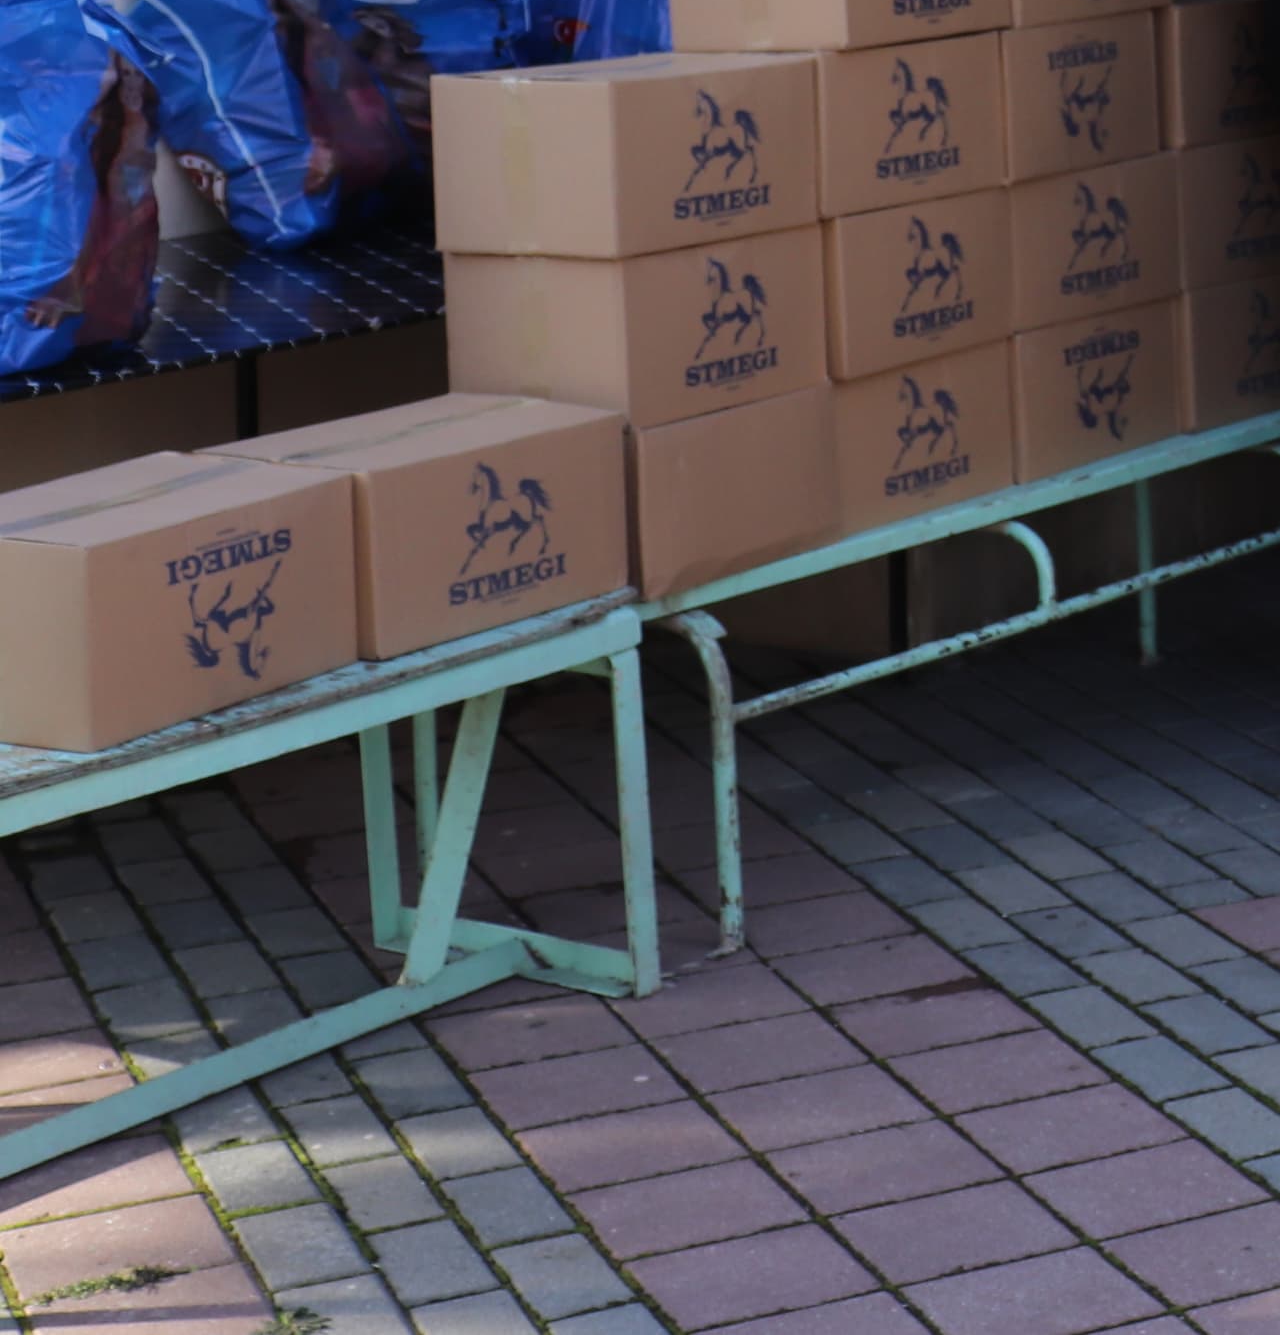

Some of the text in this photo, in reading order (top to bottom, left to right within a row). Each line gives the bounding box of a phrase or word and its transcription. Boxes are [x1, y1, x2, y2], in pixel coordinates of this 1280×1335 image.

[875, 146, 960, 179] STMEGI
[673, 183, 771, 220] STMEGI
[1059, 259, 1141, 296] STMEGI
[892, 300, 975, 338] STMEGI
[684, 346, 779, 388] STMEGI
[883, 454, 971, 497] STMEGI
[164, 527, 292, 587] STMEGI
[447, 552, 568, 607] STMEGI
